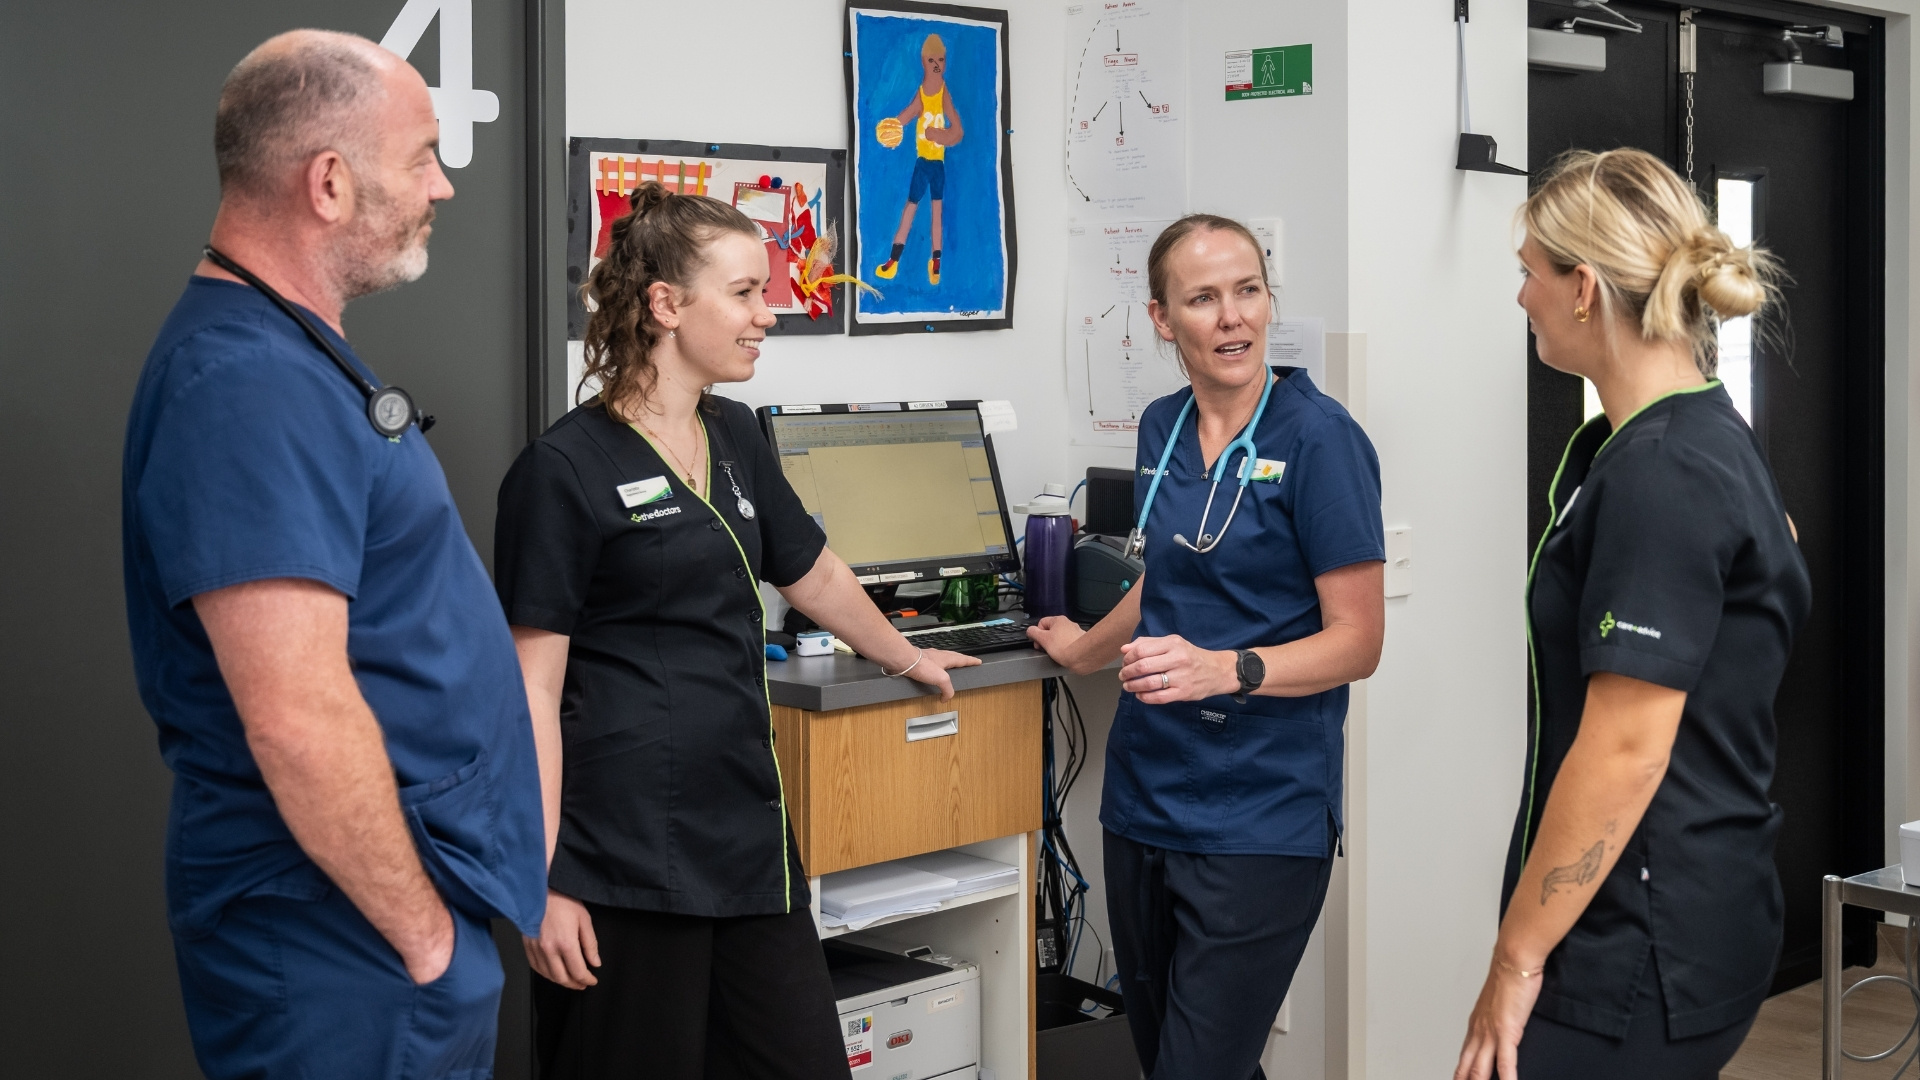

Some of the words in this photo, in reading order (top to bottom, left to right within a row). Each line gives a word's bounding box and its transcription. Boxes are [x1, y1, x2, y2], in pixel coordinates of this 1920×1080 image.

[378, 0, 500, 169] 4
[1104, 227, 1120, 235] Patient
[1110, 267, 1122, 276] Triage
[890, 1033, 910, 1046] OKI
